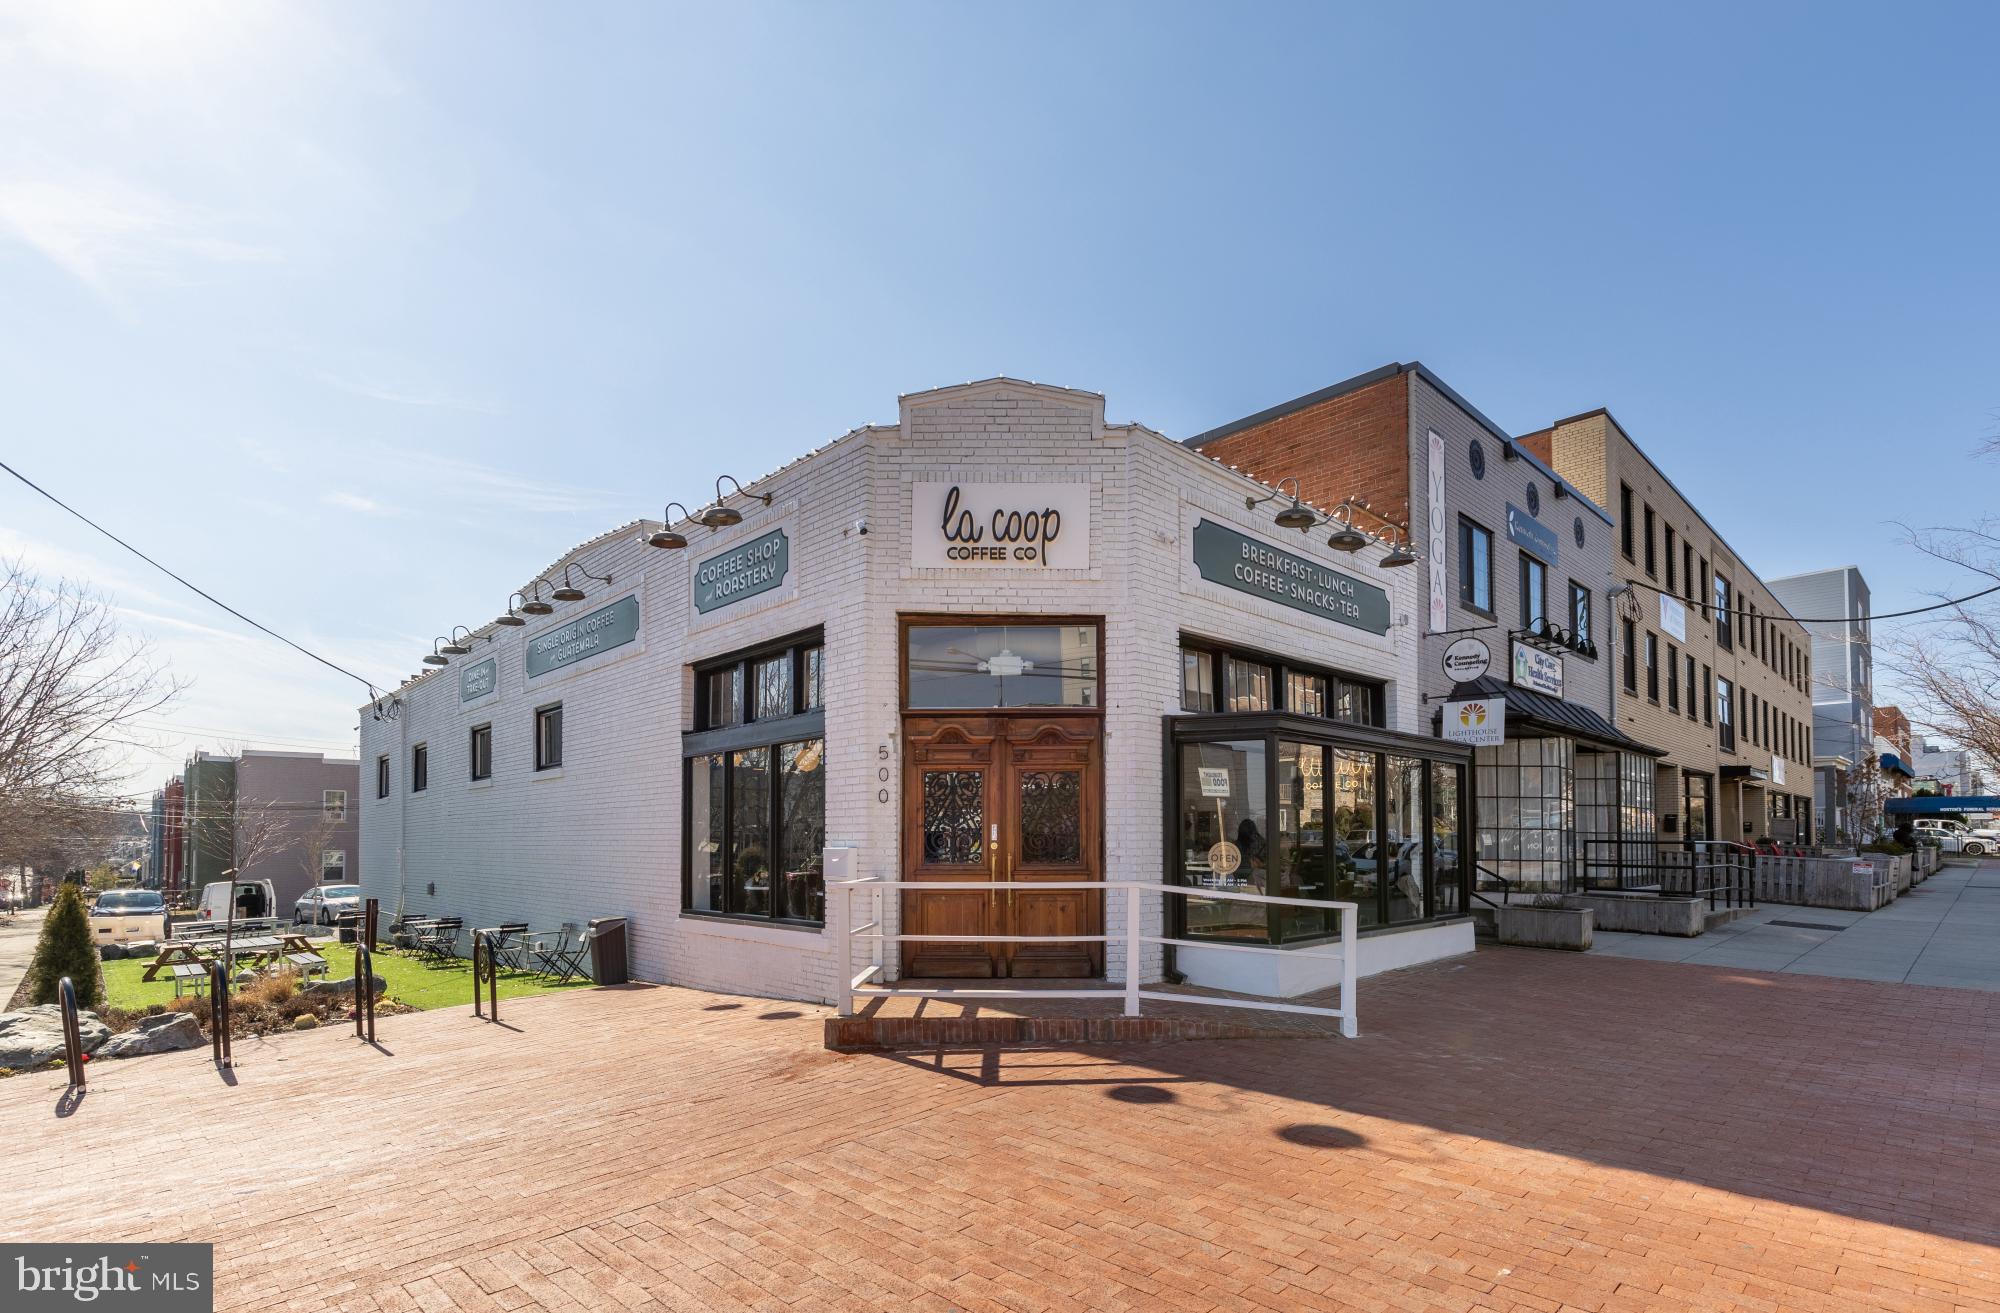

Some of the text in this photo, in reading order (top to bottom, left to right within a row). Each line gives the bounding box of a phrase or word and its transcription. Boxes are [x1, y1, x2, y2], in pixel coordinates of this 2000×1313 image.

[941, 486, 1060, 566] la coop
[1431, 470, 1443, 596] YOGA
[700, 539, 780, 584] COFFEE SHOP
[946, 546, 1037, 560] COFFEE CO
[1242, 542, 1354, 597] BREAKFAST LUNCH
[715, 561, 776, 600] ROASTERY
[1234, 563, 1359, 619] COFFEE SNACKS TEA
[537, 610, 614, 654] SINGLE ORIGIN COFFEE
[557, 634, 599, 661] GUATEMALA
[1448, 728, 1497, 737] LIGHTHOUSE
[1469, 735, 1500, 743] CENTER
[878, 745, 889, 804] 500
[1211, 854, 1239, 862] OPEN
